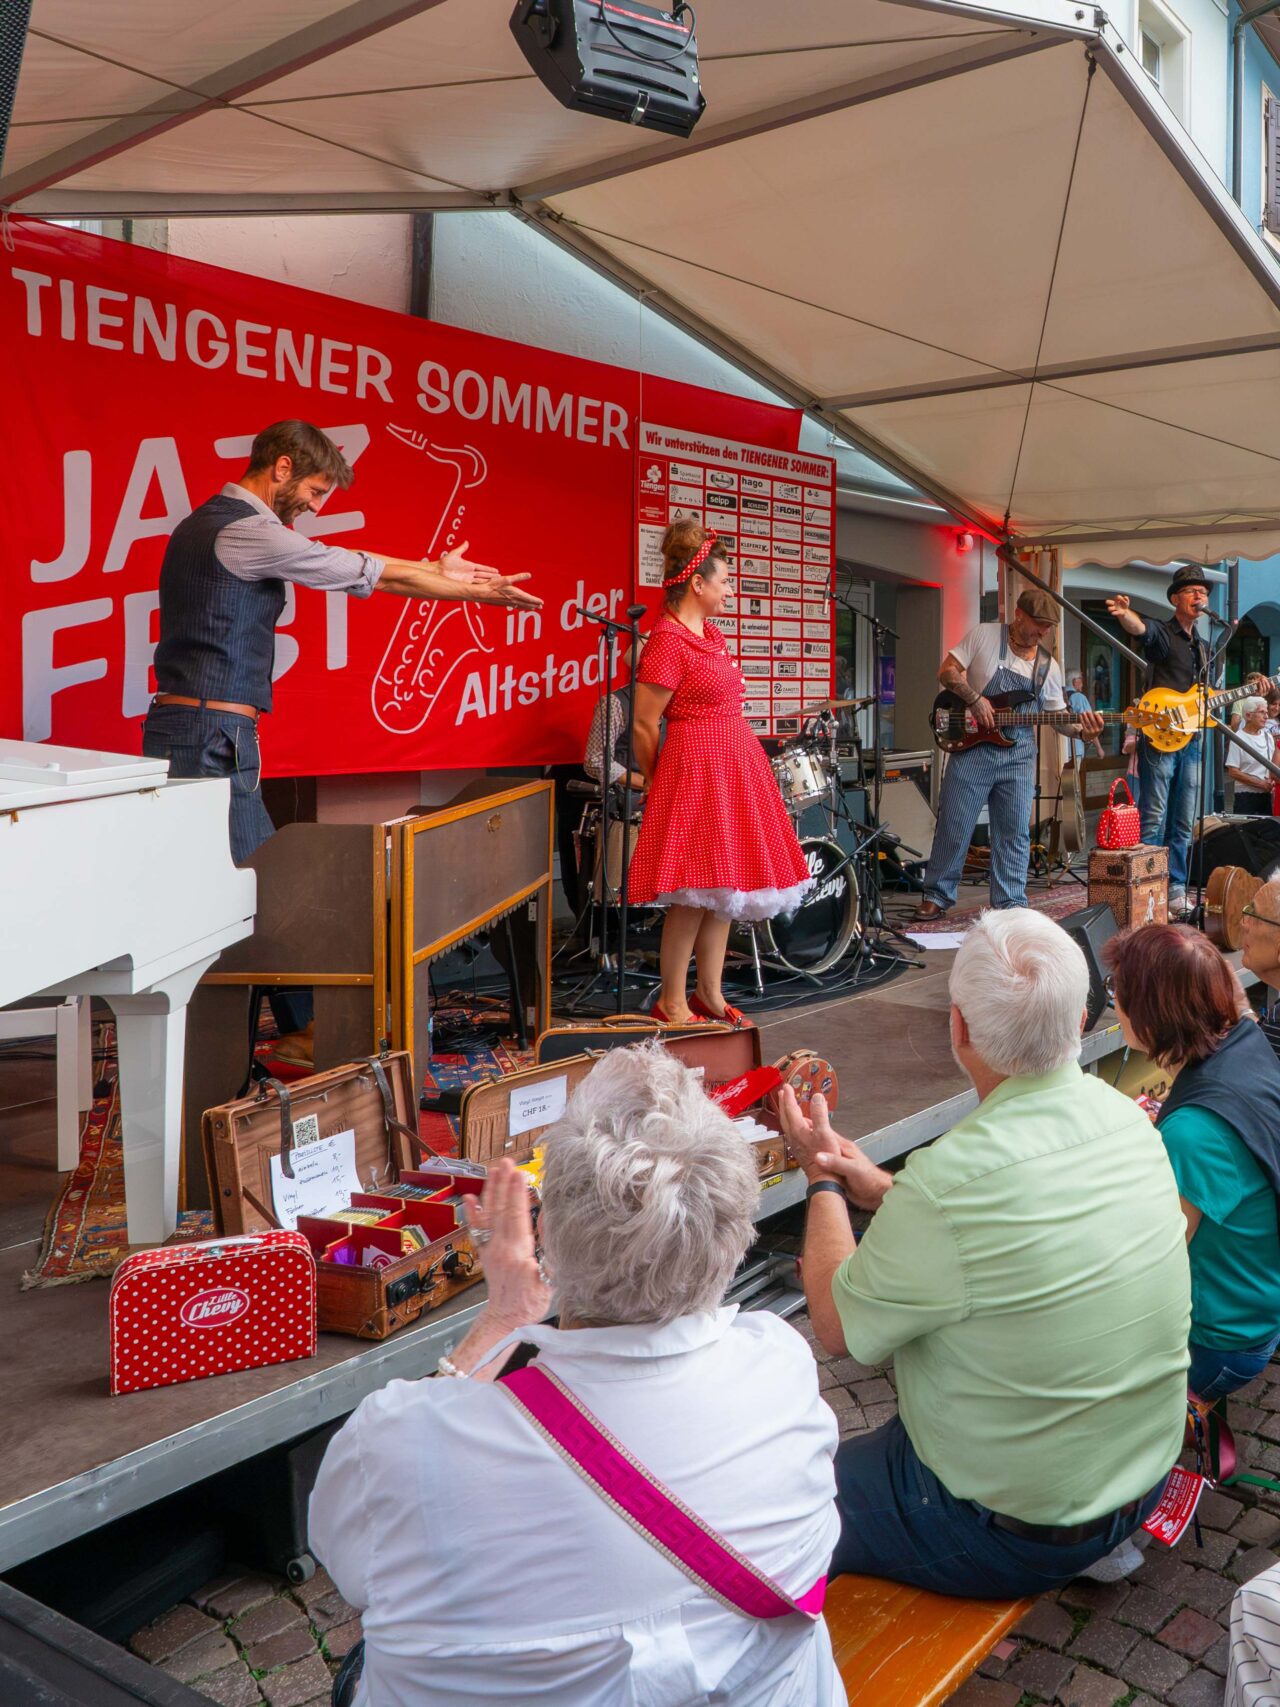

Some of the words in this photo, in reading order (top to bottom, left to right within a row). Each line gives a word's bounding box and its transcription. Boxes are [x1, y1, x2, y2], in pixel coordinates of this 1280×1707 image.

[12, 267, 393, 403] TIENGENER
[416, 360, 631, 450] SOMMER
[646, 431, 662, 446] Wir
[665, 438, 720, 457] unterstützen
[722, 448, 738, 460] den
[741, 450, 789, 469] TIENGENER
[791, 459, 829, 478] SOMMER:
[742, 477, 763, 488] hago
[31, 423, 371, 583] JAZ
[710, 496, 730, 505] seipp
[780, 506, 801, 515] FLOHR
[775, 564, 799, 573] Simmler
[774, 583, 800, 595] Tomasi
[506, 604, 542, 646] in
[560, 580, 623, 631] der
[707, 618, 735, 627] RE/MAX
[455, 635, 622, 726] Altstadt
[522, 1107, 537, 1117] CHF
[208, 1292, 238, 1306] Little
[189, 1299, 244, 1321] Chevy
